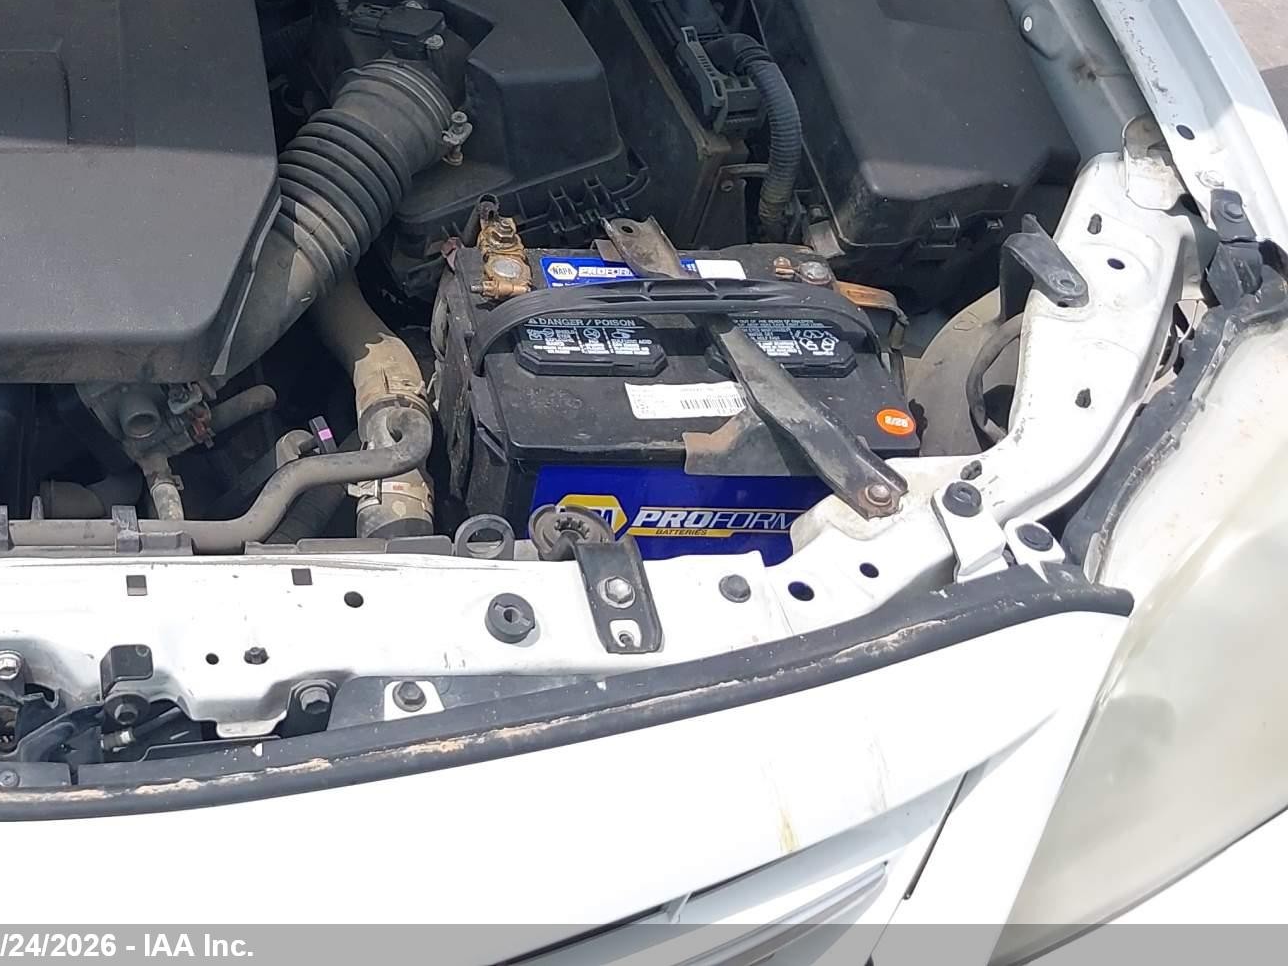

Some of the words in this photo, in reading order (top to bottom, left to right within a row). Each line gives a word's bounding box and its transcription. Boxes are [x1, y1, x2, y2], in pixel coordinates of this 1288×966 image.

[552, 266, 573, 276] NAPA
[538, 318, 584, 326] DANGER
[654, 528, 707, 536] BATTERIES
